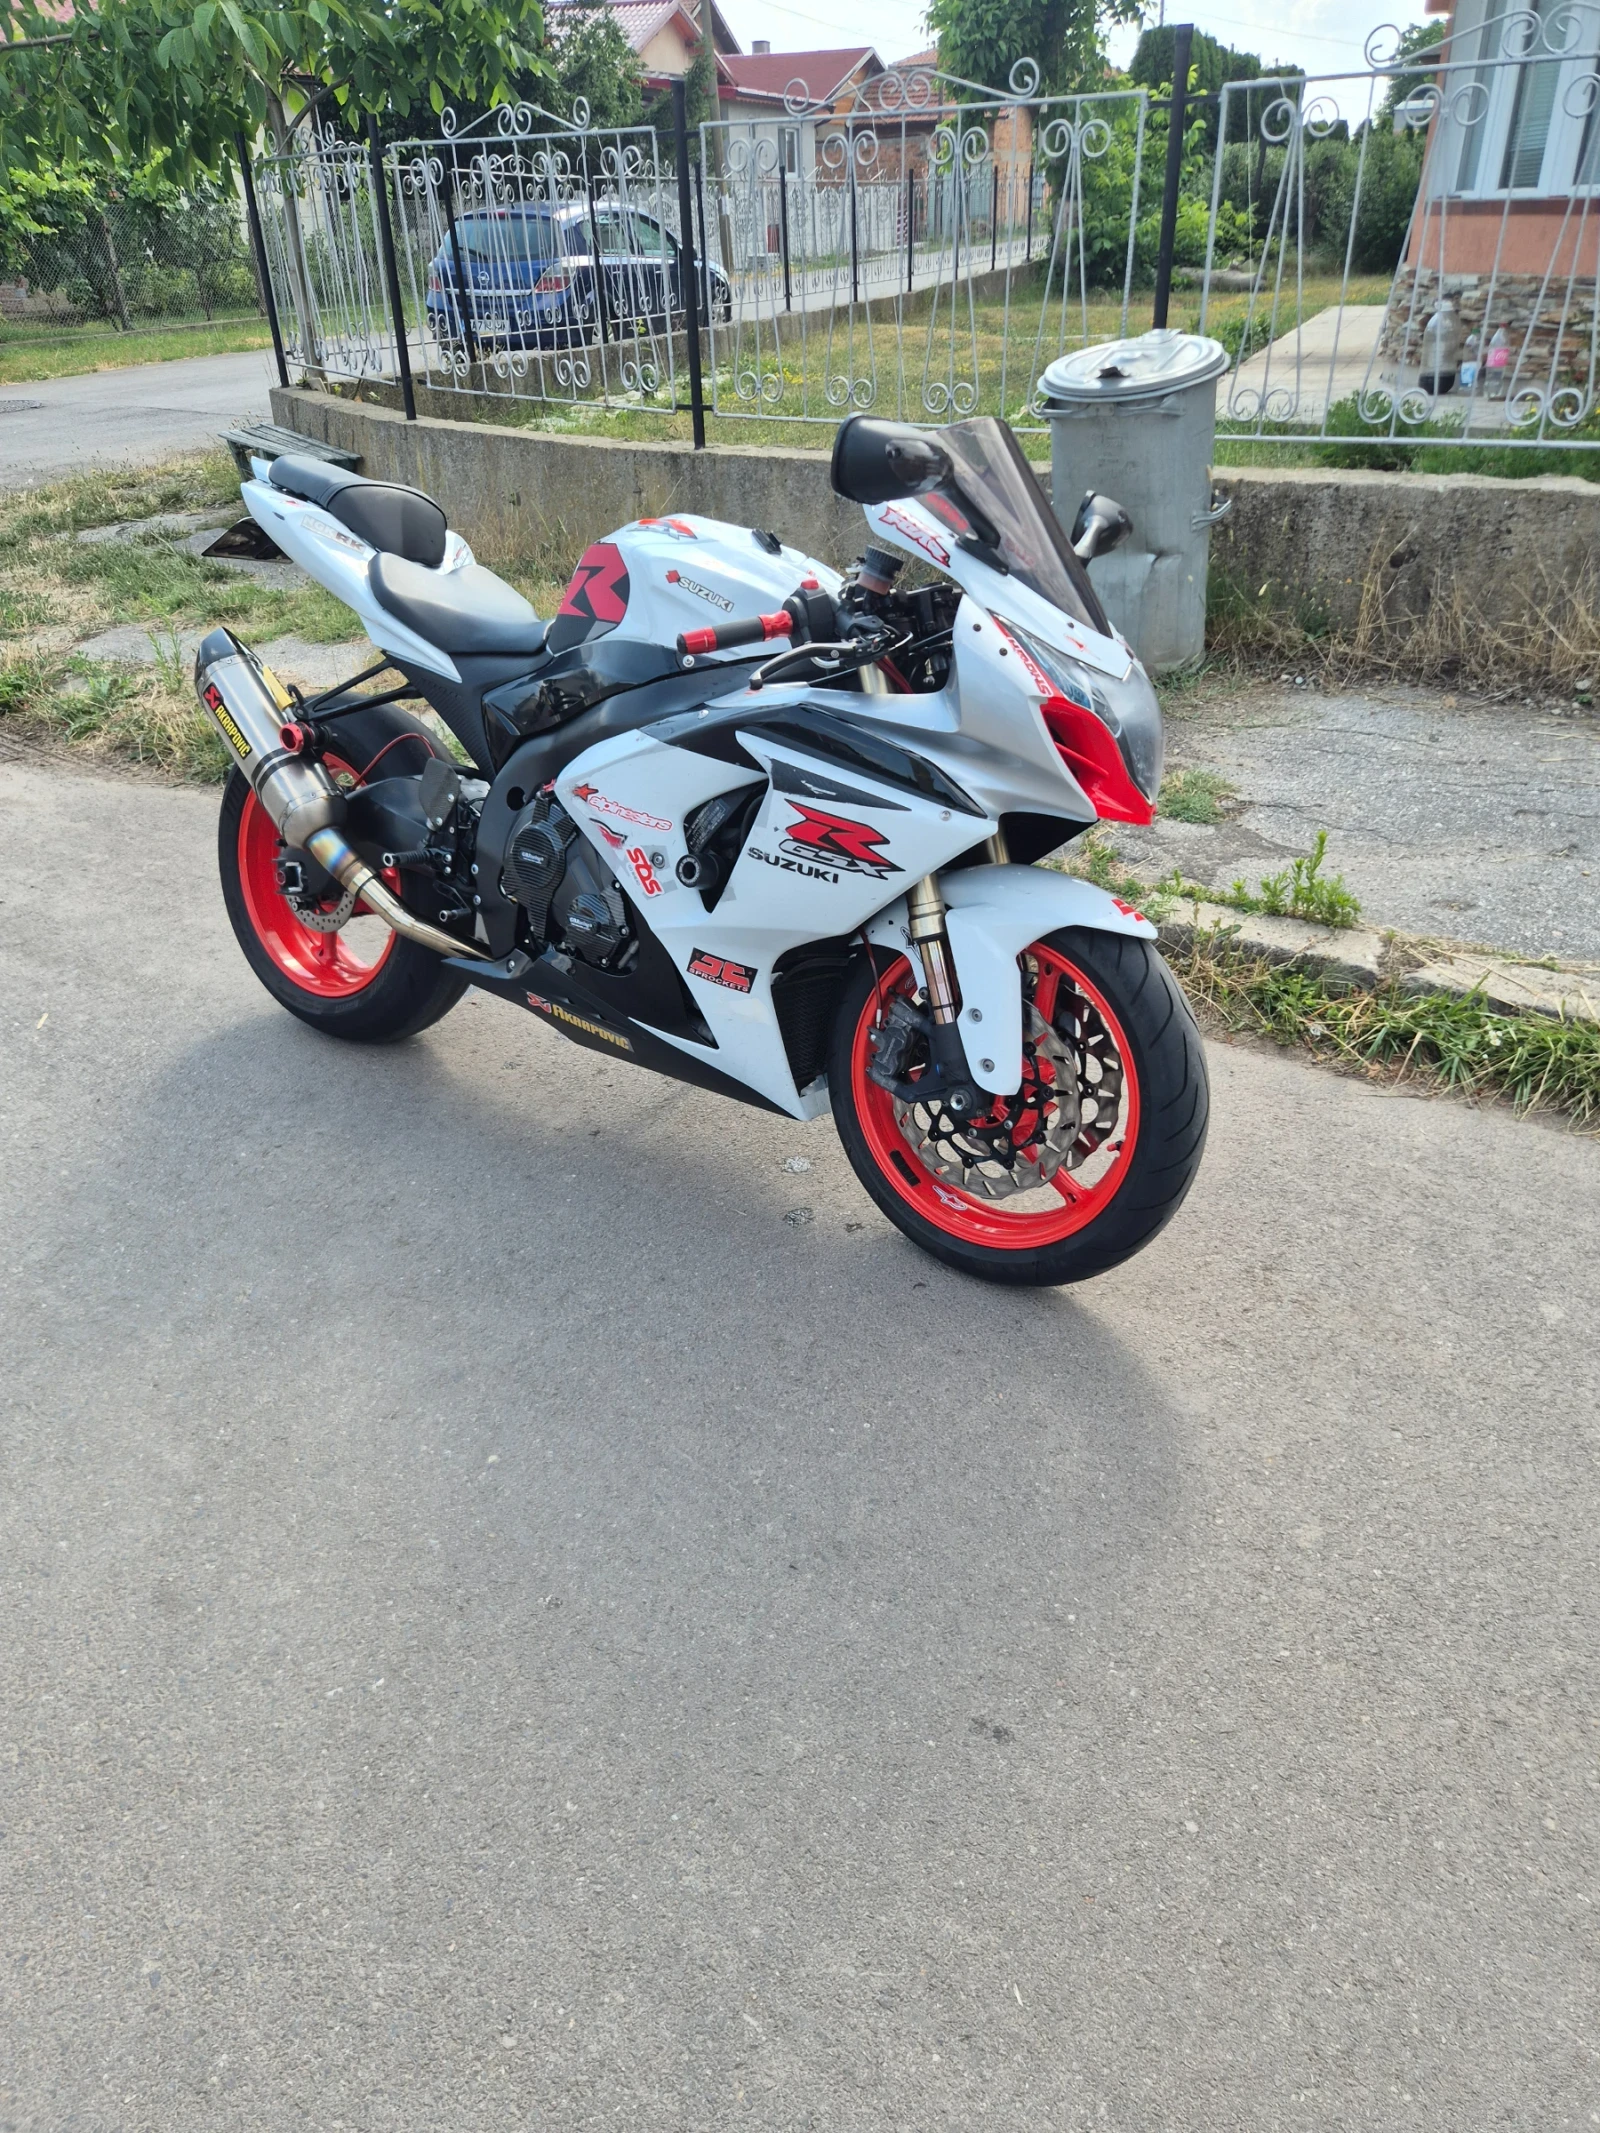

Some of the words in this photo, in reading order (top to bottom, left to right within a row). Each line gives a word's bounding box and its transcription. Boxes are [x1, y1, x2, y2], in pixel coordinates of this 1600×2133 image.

[678, 576, 734, 613] SUZUKI
[589, 796, 672, 831] alpinestars
[748, 847, 839, 884] SUZUKI
[688, 967, 749, 992] SPROCKETS
